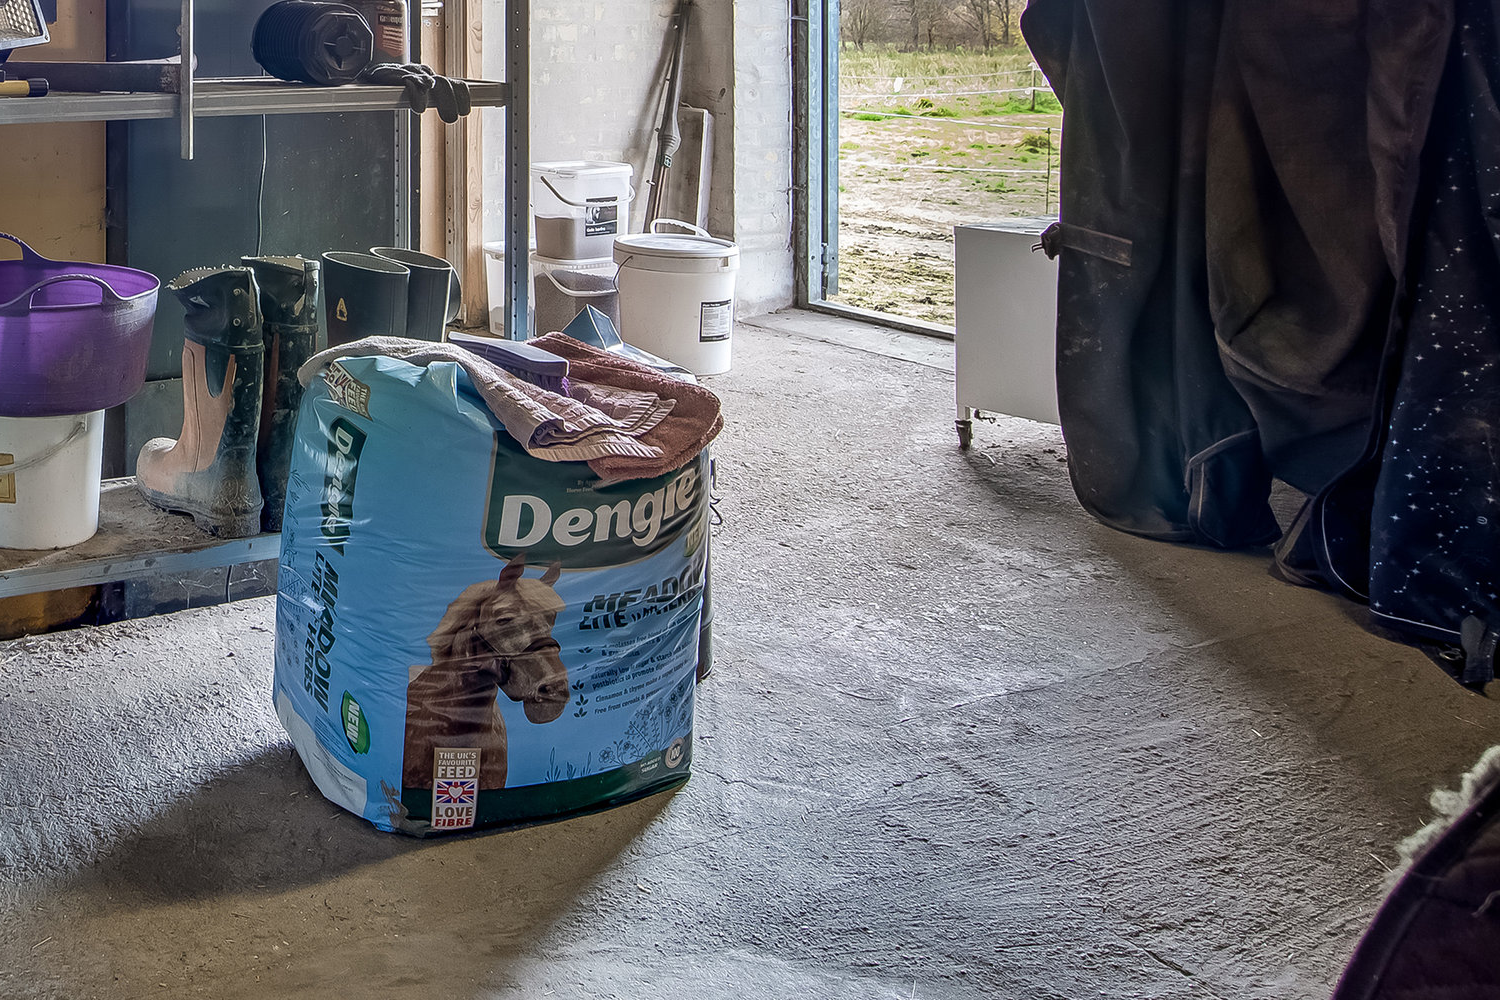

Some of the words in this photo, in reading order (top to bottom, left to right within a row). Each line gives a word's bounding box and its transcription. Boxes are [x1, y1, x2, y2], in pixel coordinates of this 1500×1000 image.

[498, 467, 697, 548] Dengie
[304, 622, 317, 697] HERBS
[632, 667, 654, 680] promote
[596, 690, 622, 702] Cinnamon
[608, 703, 620, 711] from
[347, 699, 360, 744] NEW
[457, 751, 477, 759] UK'S
[437, 766, 476, 778] FEED
[435, 806, 473, 818] LOVE
[434, 817, 473, 827] FIBRE
